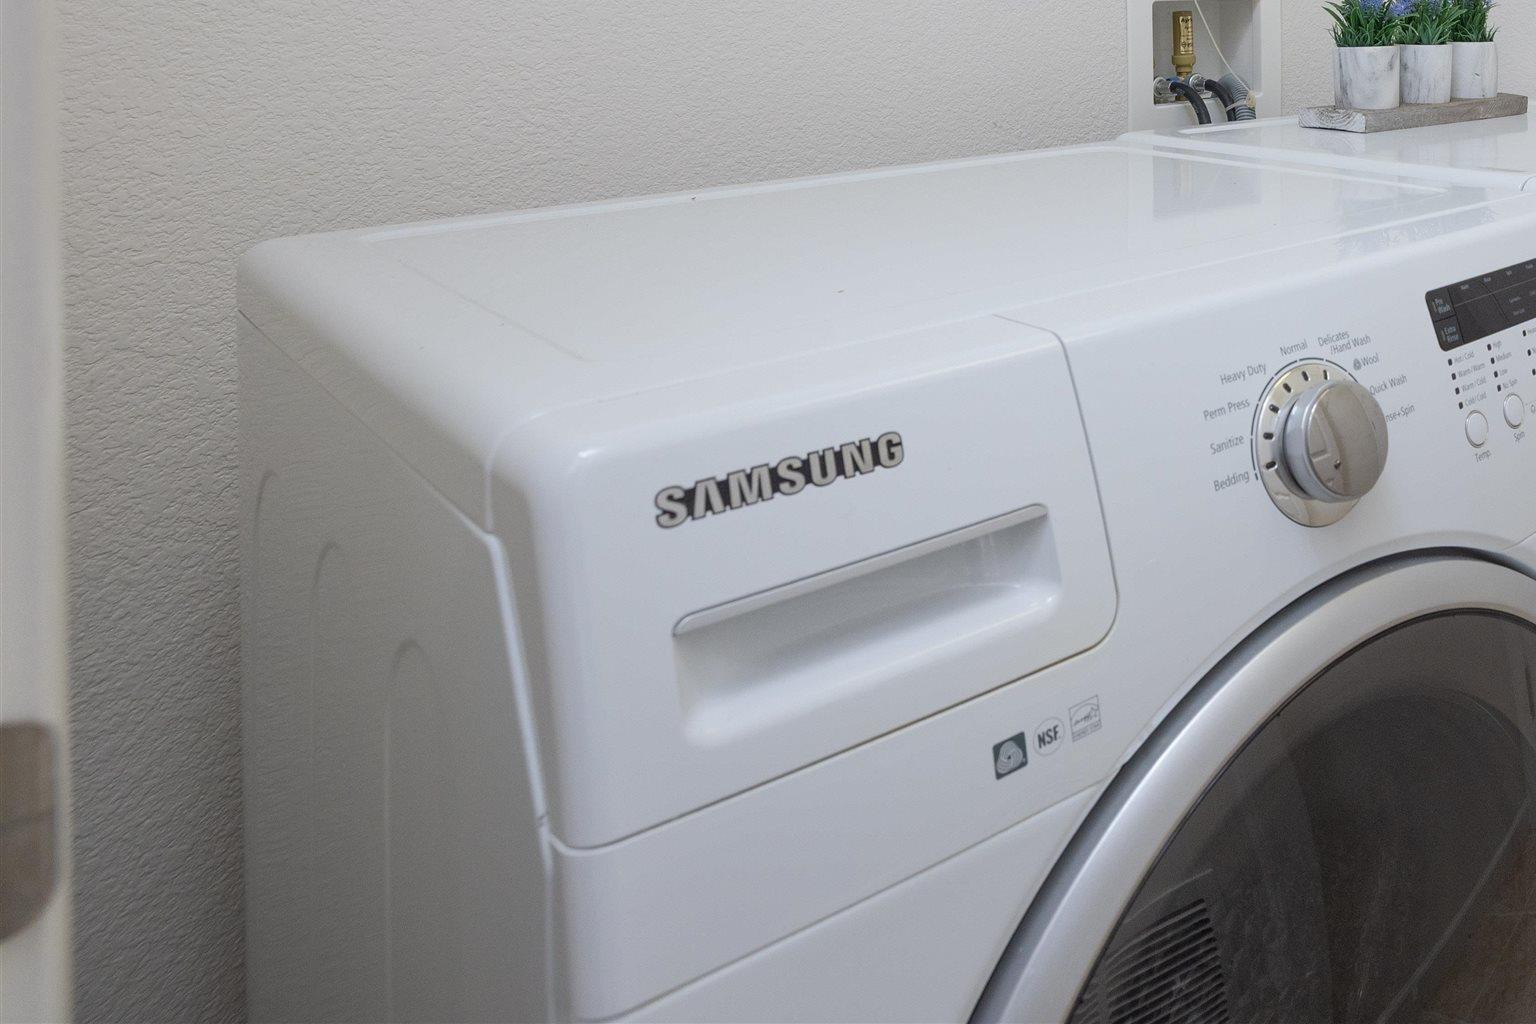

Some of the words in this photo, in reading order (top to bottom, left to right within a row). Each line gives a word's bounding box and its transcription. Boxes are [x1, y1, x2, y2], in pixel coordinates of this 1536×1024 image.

[1280, 339, 1308, 356] Normal
[1318, 331, 1350, 347] Delicates
[1353, 334, 1371, 348] Wash
[1361, 353, 1380, 367] Wool
[1219, 371, 1246, 385] Heavy
[1247, 363, 1267, 376] Duty
[1369, 383, 1388, 396] Quick
[1389, 374, 1408, 388] Wash
[1203, 404, 1226, 420] Perm
[1227, 399, 1250, 413] Press
[1210, 435, 1245, 456] Sanitize
[1513, 430, 1526, 444] Spin
[654, 431, 905, 529] SAMSUNG
[1213, 471, 1250, 492] Bedding
[1037, 724, 1059, 749] NSF
